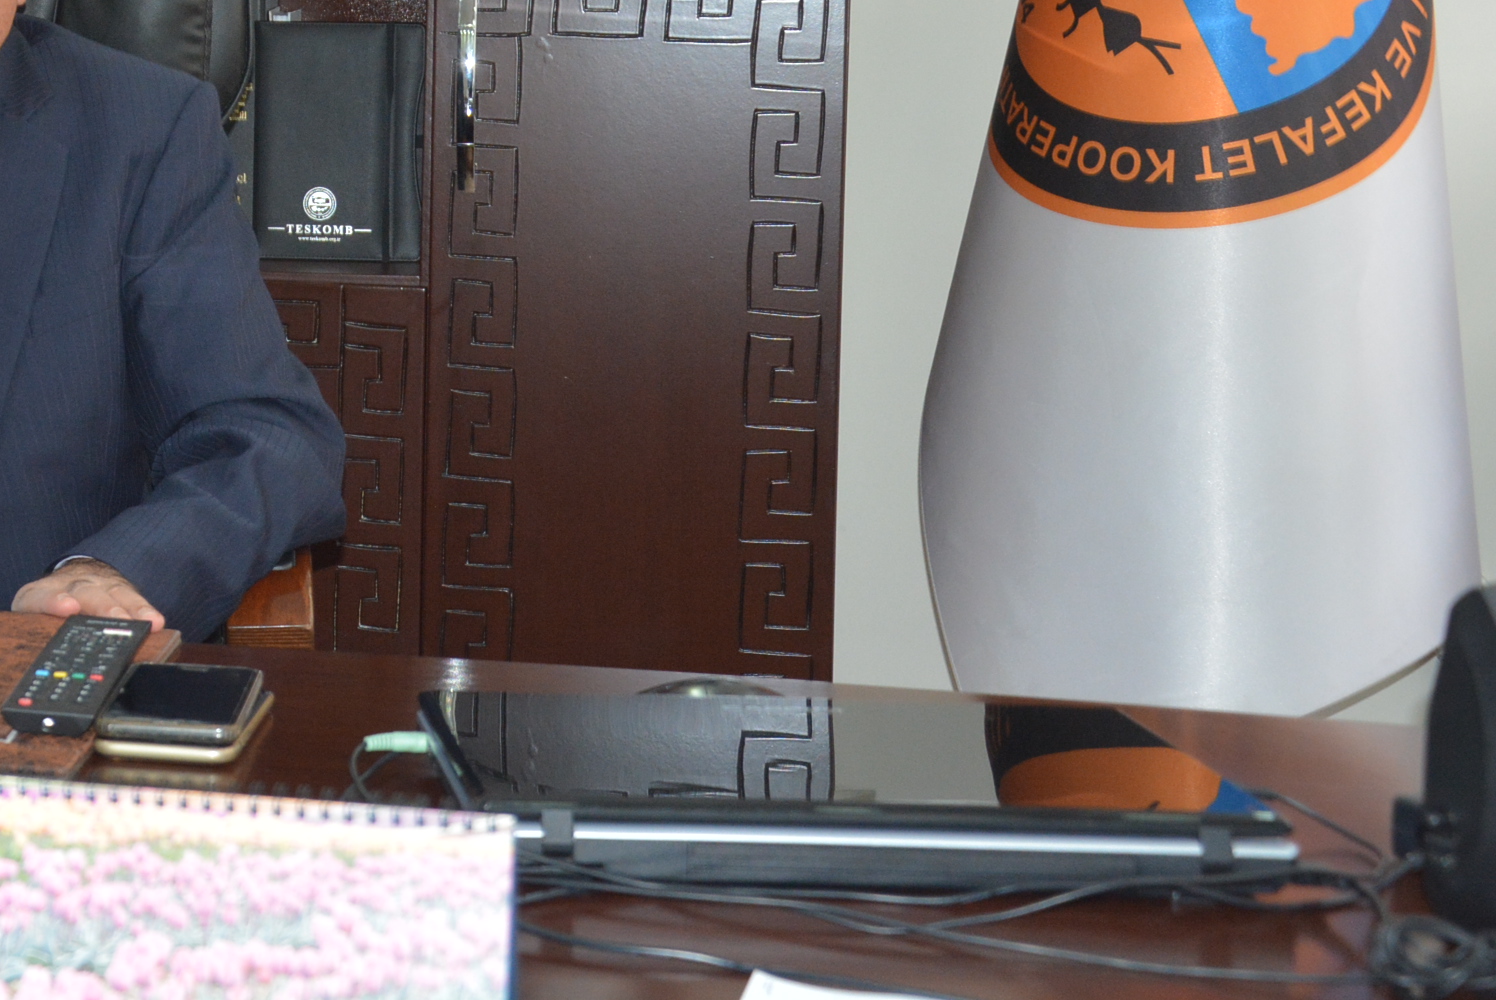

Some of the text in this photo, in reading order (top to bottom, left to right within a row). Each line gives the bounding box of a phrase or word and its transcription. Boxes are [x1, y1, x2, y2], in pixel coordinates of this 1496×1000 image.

[1384, 19, 1423, 79] VE
[1194, 68, 1393, 182] KEFALET
[286, 223, 354, 236] TESKOMB
